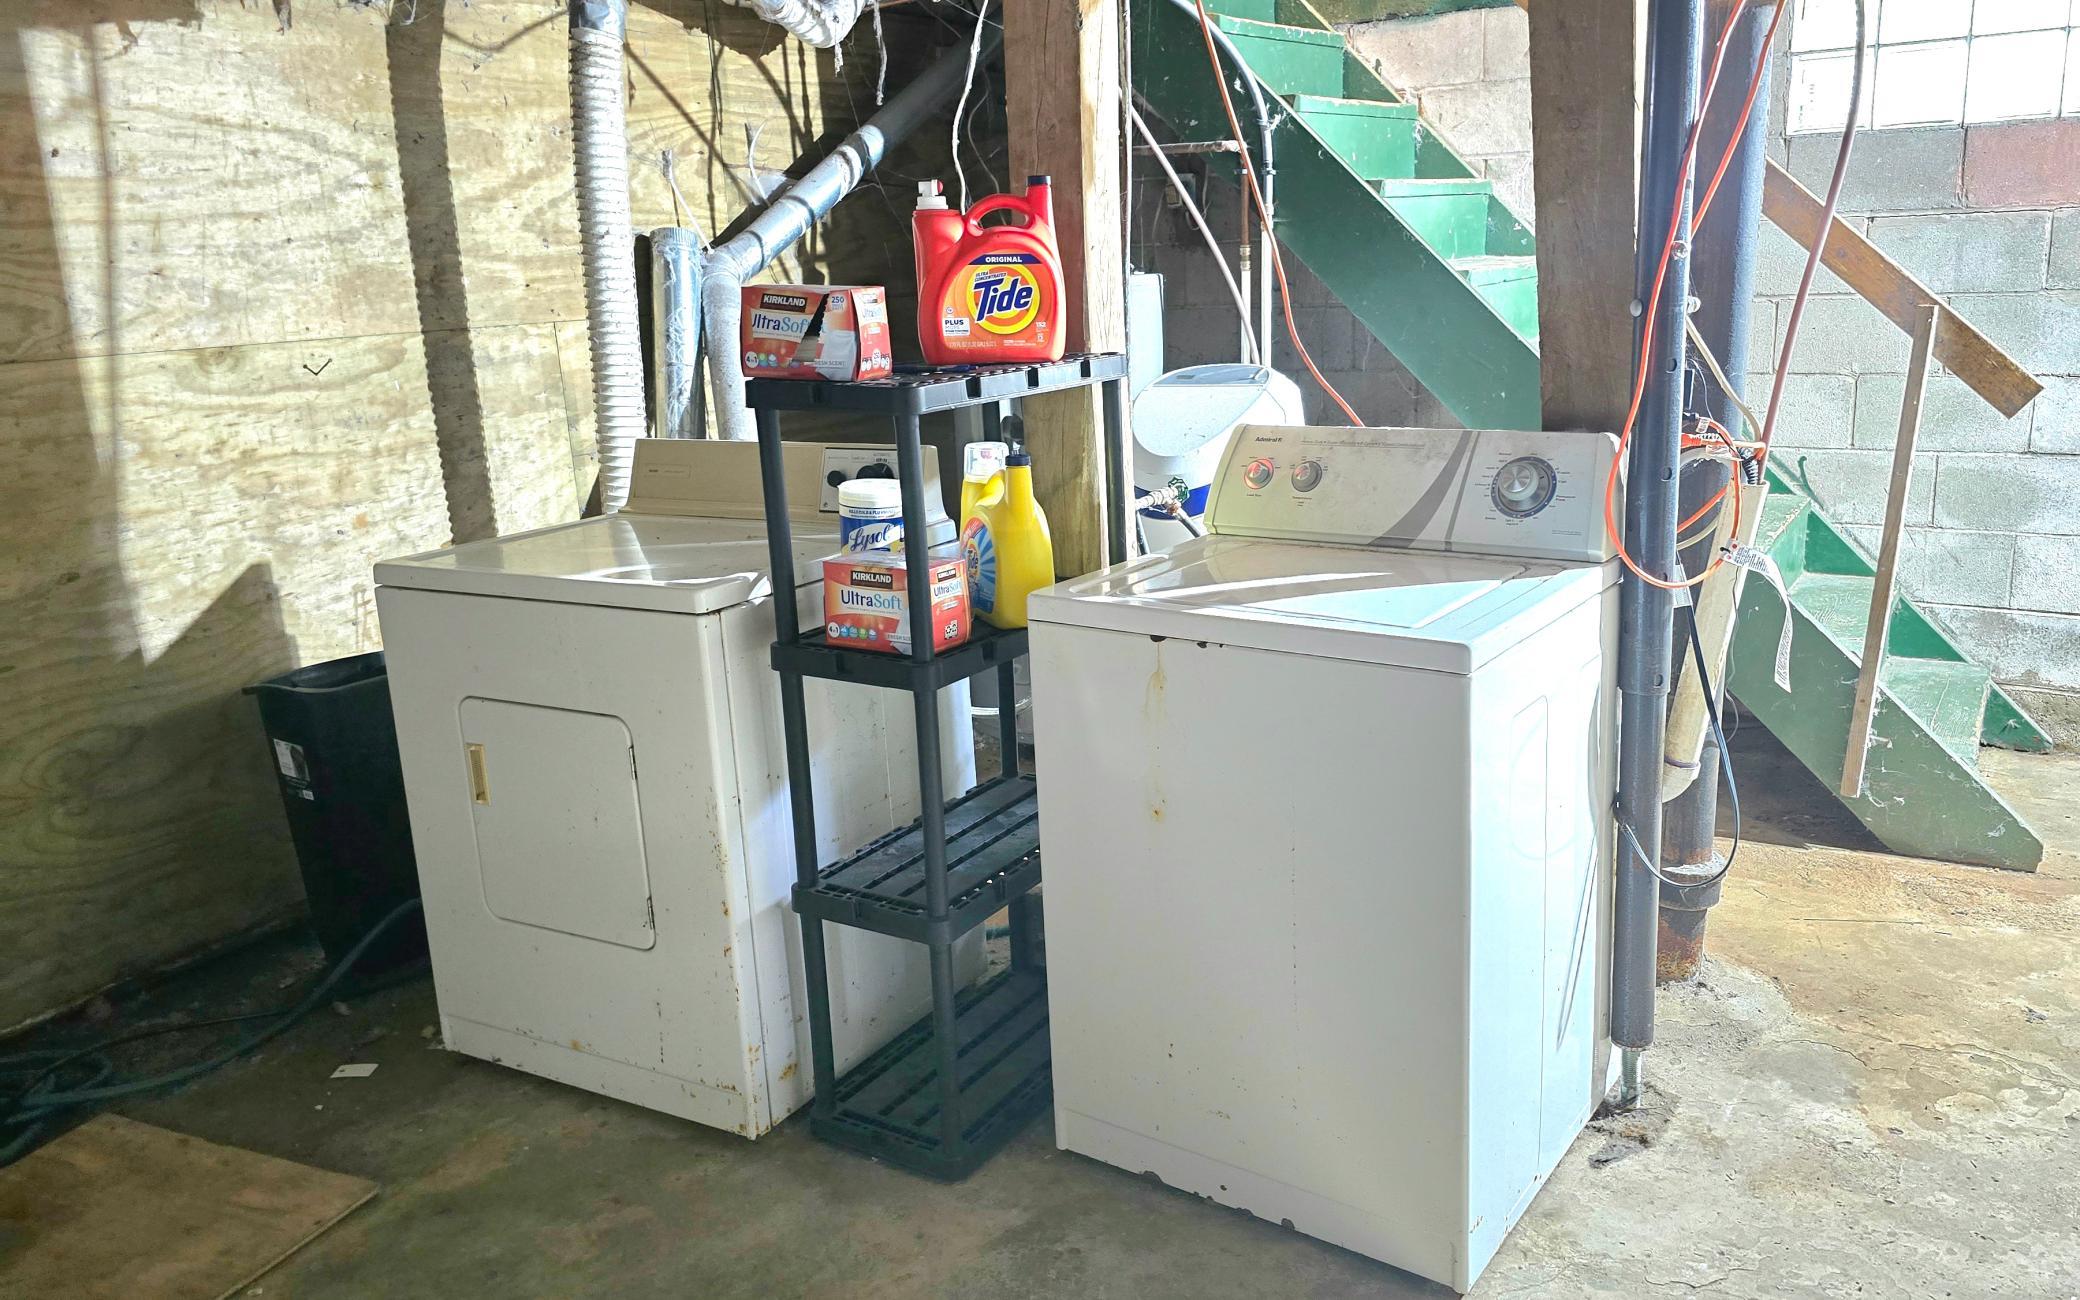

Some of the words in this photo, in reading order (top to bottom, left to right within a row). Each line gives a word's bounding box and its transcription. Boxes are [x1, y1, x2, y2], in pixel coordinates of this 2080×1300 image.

[763, 294, 805, 307] KIRKLAND
[973, 277, 1033, 322] Tide
[850, 524, 890, 551] Lysol
[852, 571, 892, 584] KIRKLAND
[841, 589, 903, 610] UltraSoft
